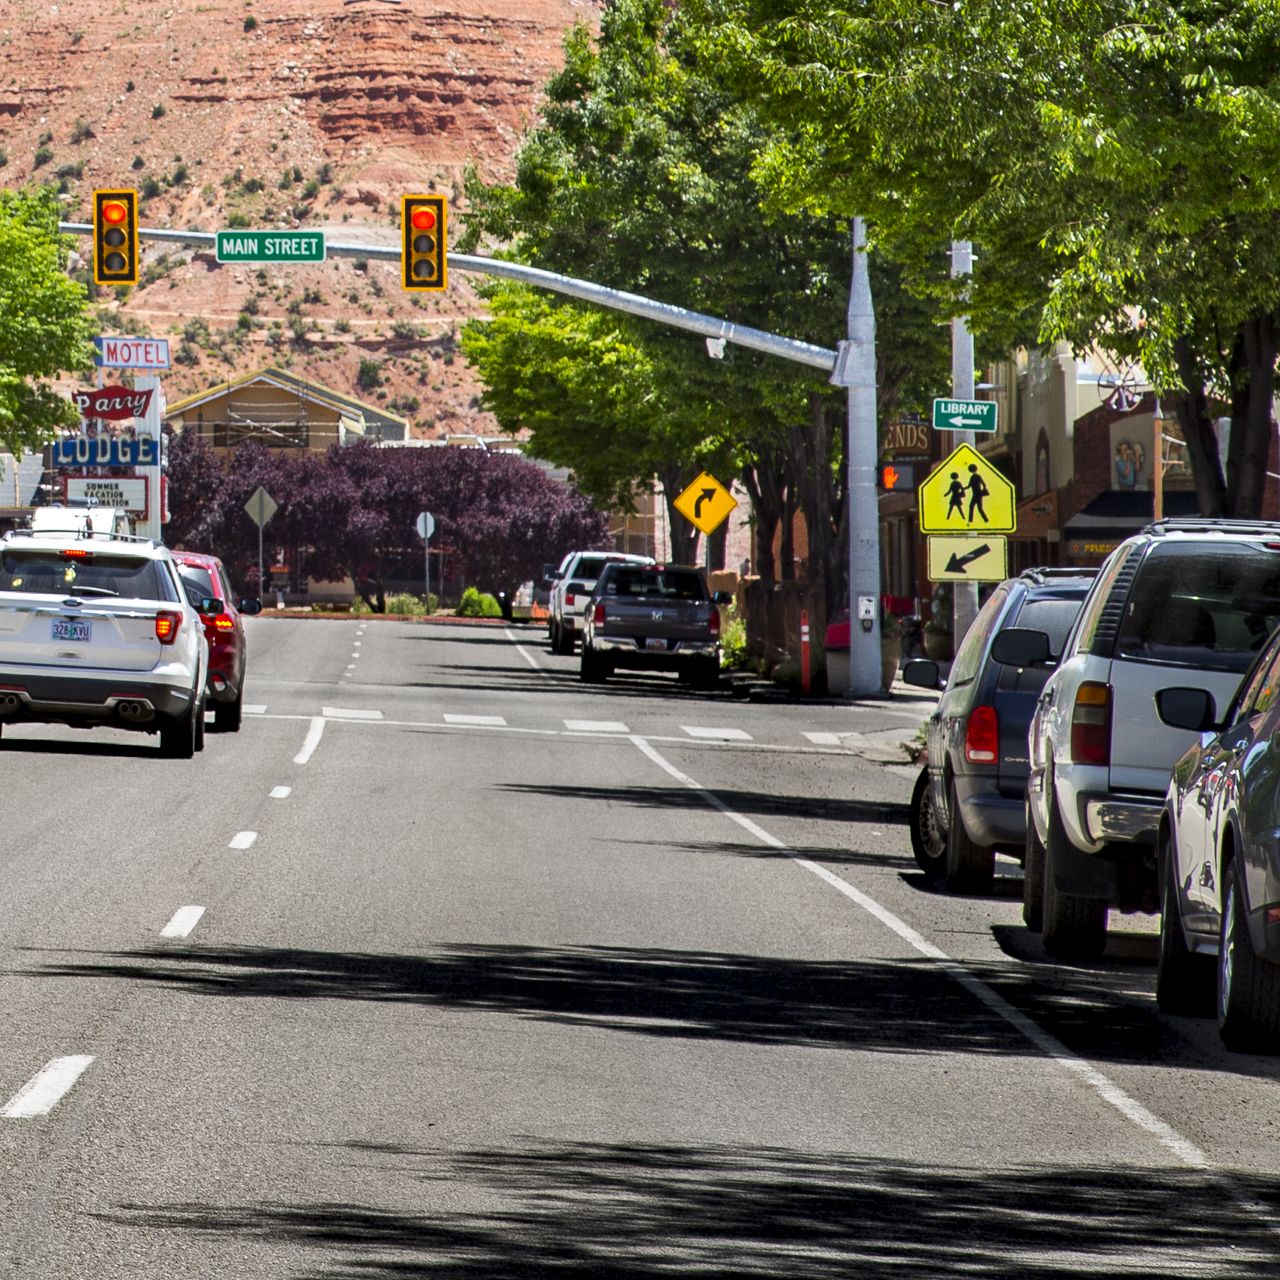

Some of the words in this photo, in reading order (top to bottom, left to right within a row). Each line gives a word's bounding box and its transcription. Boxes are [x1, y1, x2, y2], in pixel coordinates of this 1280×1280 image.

[223, 238, 258, 255] MAIN
[264, 238, 318, 255] STREET
[106, 342, 166, 364] MOTEL
[75, 394, 147, 416] Parry
[940, 402, 989, 415] LIBRARY
[57, 432, 153, 463] LODGE
